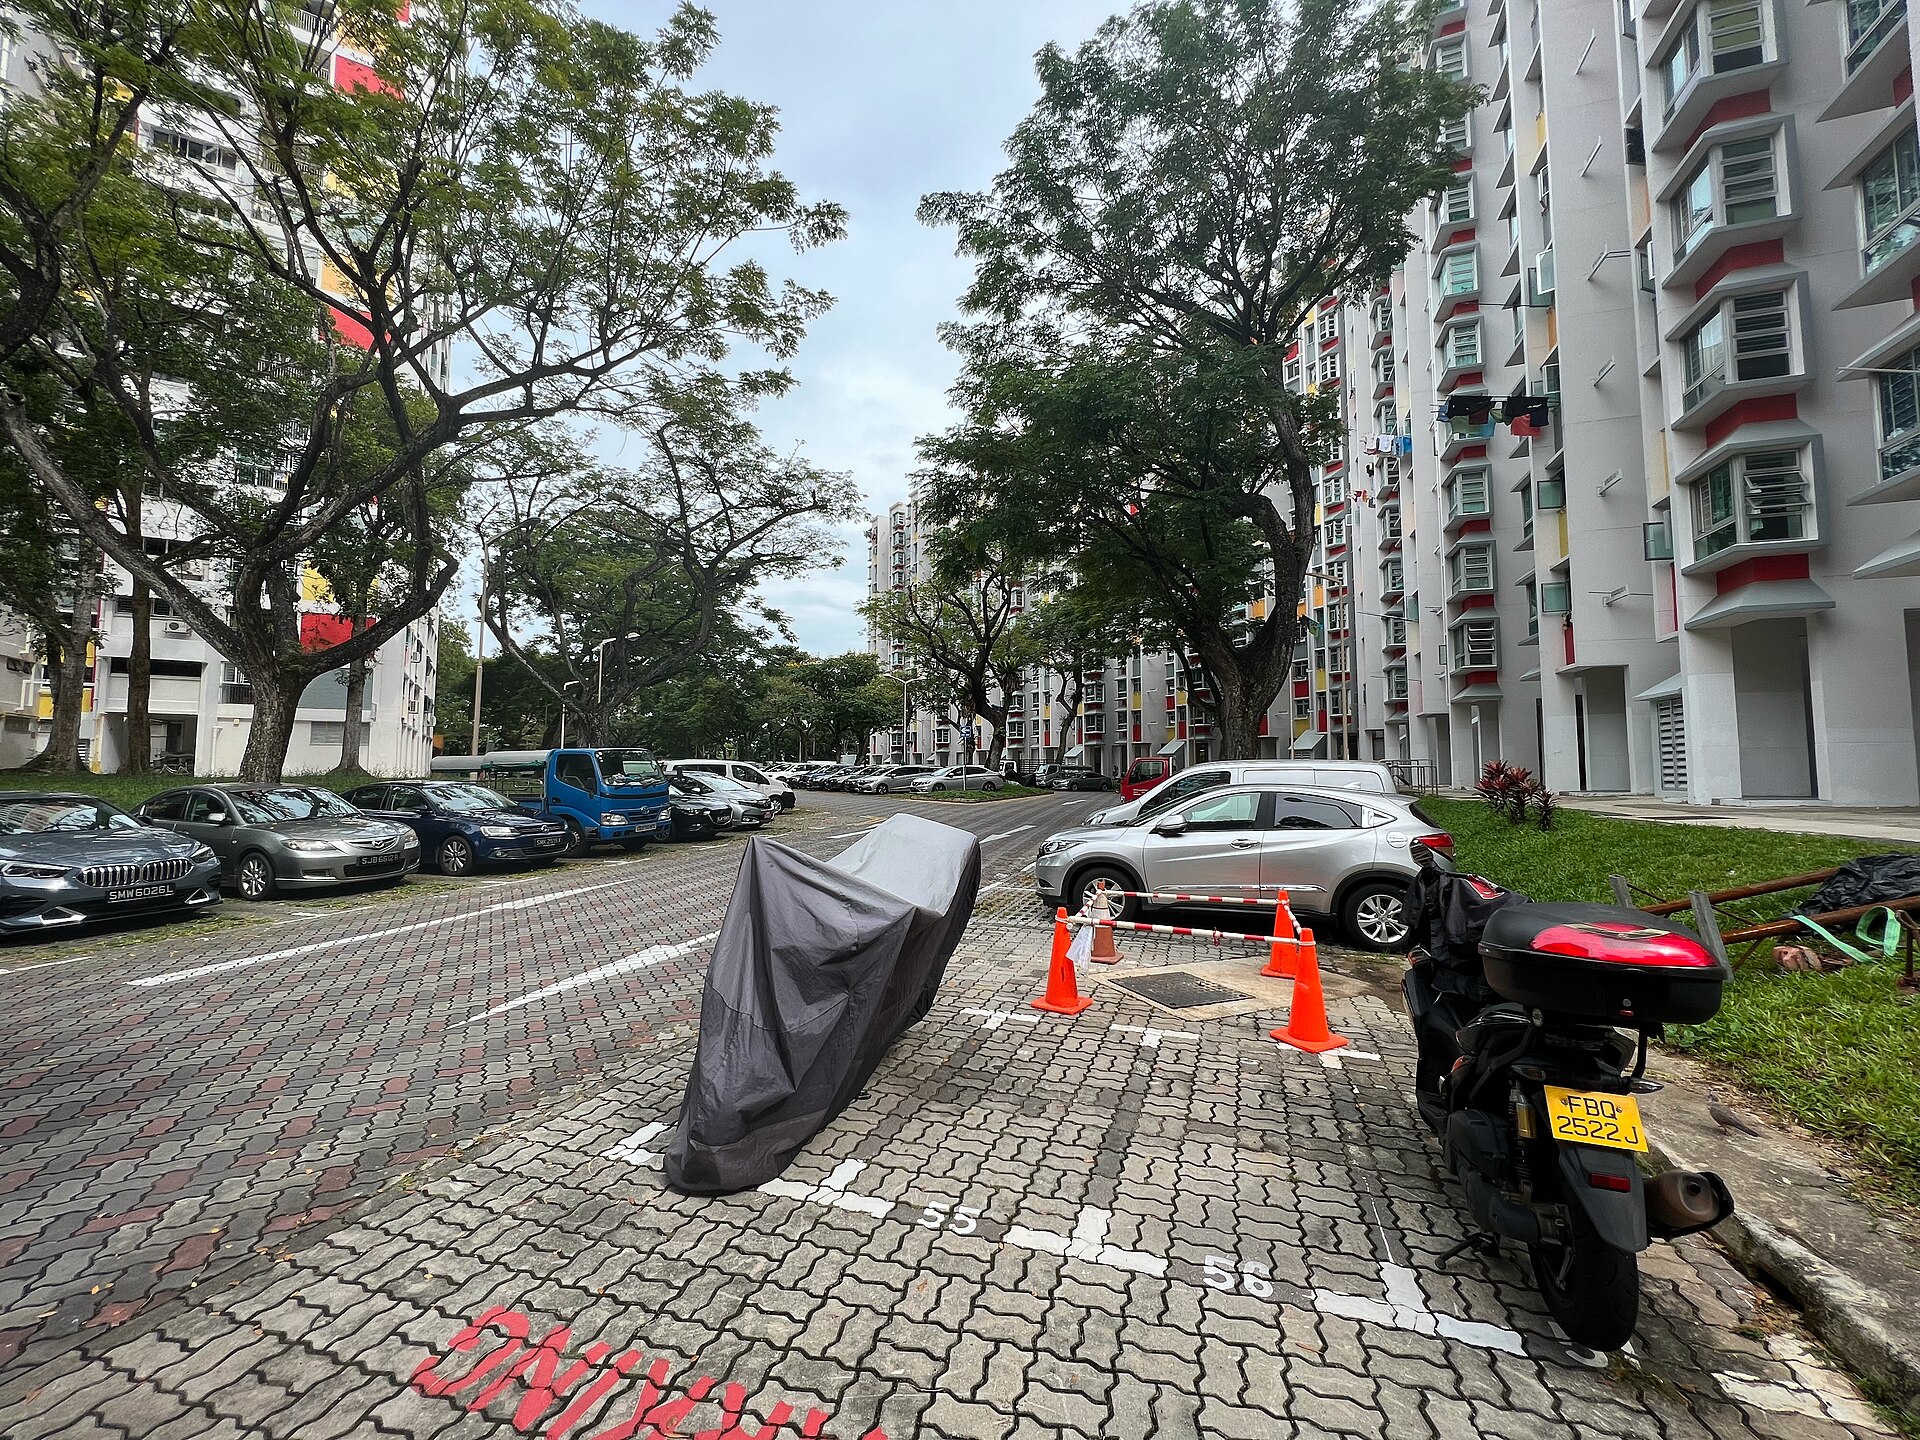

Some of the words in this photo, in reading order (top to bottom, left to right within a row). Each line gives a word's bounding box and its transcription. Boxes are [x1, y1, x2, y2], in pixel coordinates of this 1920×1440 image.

[109, 884, 174, 900] SMW6026L
[1567, 1095, 1617, 1120] FBQ
[1556, 1115, 1639, 1144] 2522J
[916, 1200, 982, 1234] 55
[1203, 1253, 1274, 1298] 56
